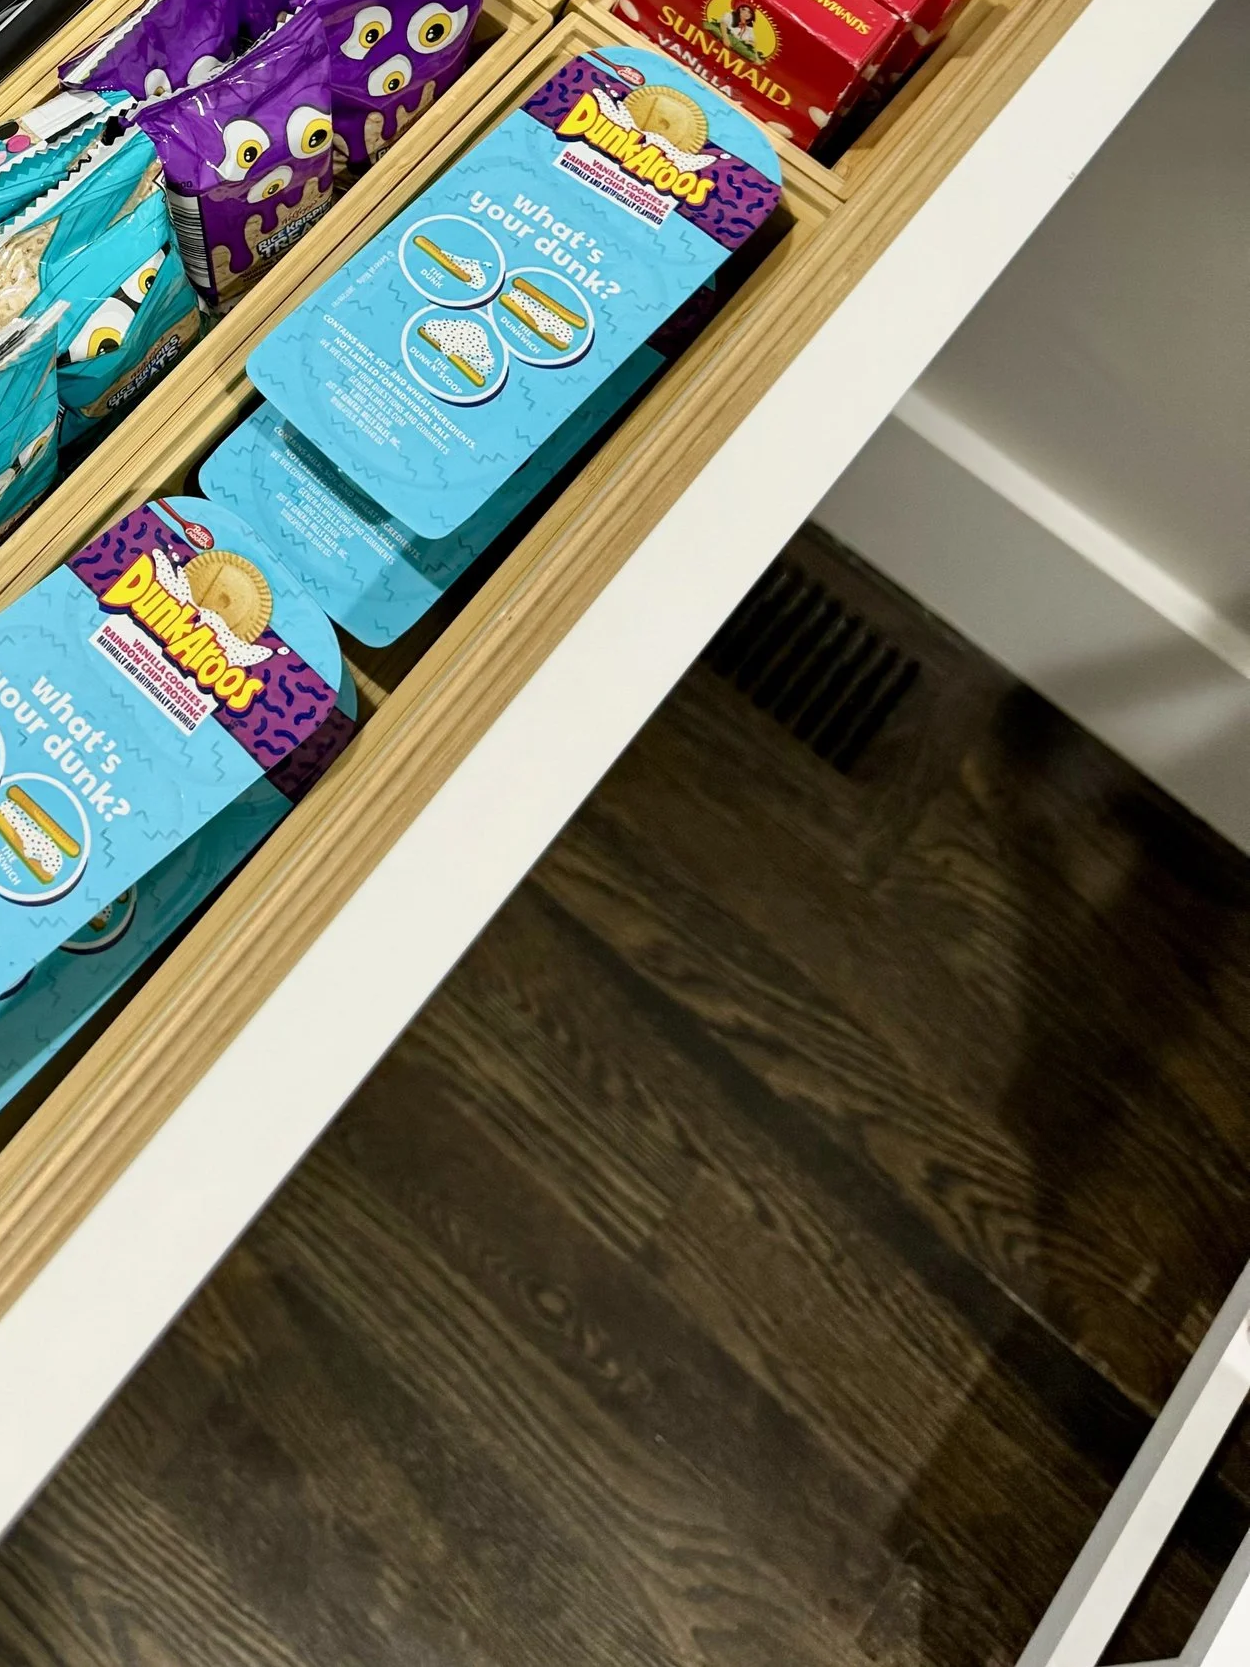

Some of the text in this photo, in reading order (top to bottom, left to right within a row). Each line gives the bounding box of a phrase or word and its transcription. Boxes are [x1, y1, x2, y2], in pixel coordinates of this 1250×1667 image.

[657, 33, 734, 98] VANILLA
[562, 150, 667, 218] RAINBOW CHIP FROSTING
[592, 158, 664, 209] VANILLA COOKIES
[468, 190, 622, 300] your dunk?
[512, 194, 605, 264] what's
[419, 269, 443, 289] DUNK
[428, 266, 446, 281] THE
[499, 316, 542, 355] DUNKWICH
[333, 336, 451, 442] NOT LABELED FOR INDIVIDUAL SALE
[96, 634, 198, 732] NATURALLY FLAVORED
[102, 625, 202, 722] RAINBOW CHIP FROSTING
[132, 638, 204, 707] VANILLA COOKIES
[31, 675, 122, 775] what's
[43, 734, 131, 822] dunk?
